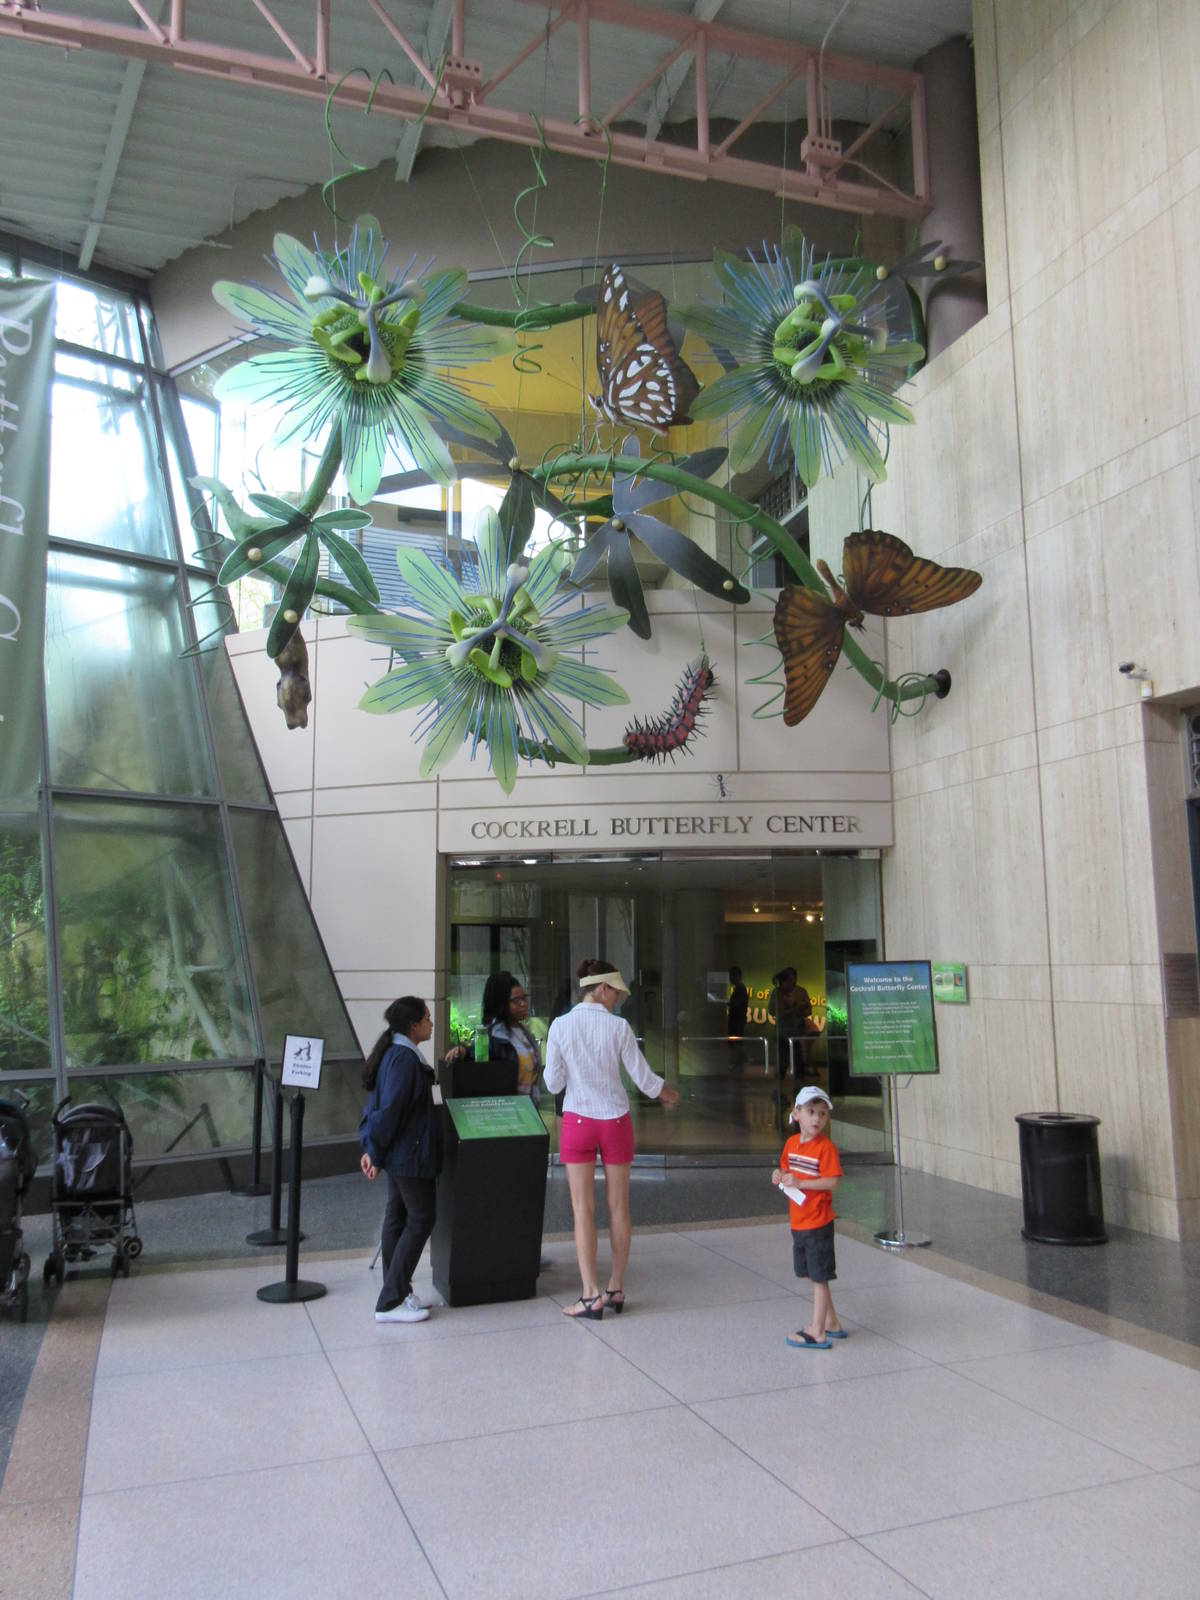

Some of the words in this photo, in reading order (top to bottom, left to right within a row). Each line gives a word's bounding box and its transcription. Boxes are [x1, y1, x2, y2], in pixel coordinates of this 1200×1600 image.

[471, 818, 598, 840] COCKRELL
[611, 816, 754, 836] BUTTERFLY
[765, 814, 863, 834] CENTER
[877, 984, 905, 992] Butterfly
[906, 983, 928, 991] Center
